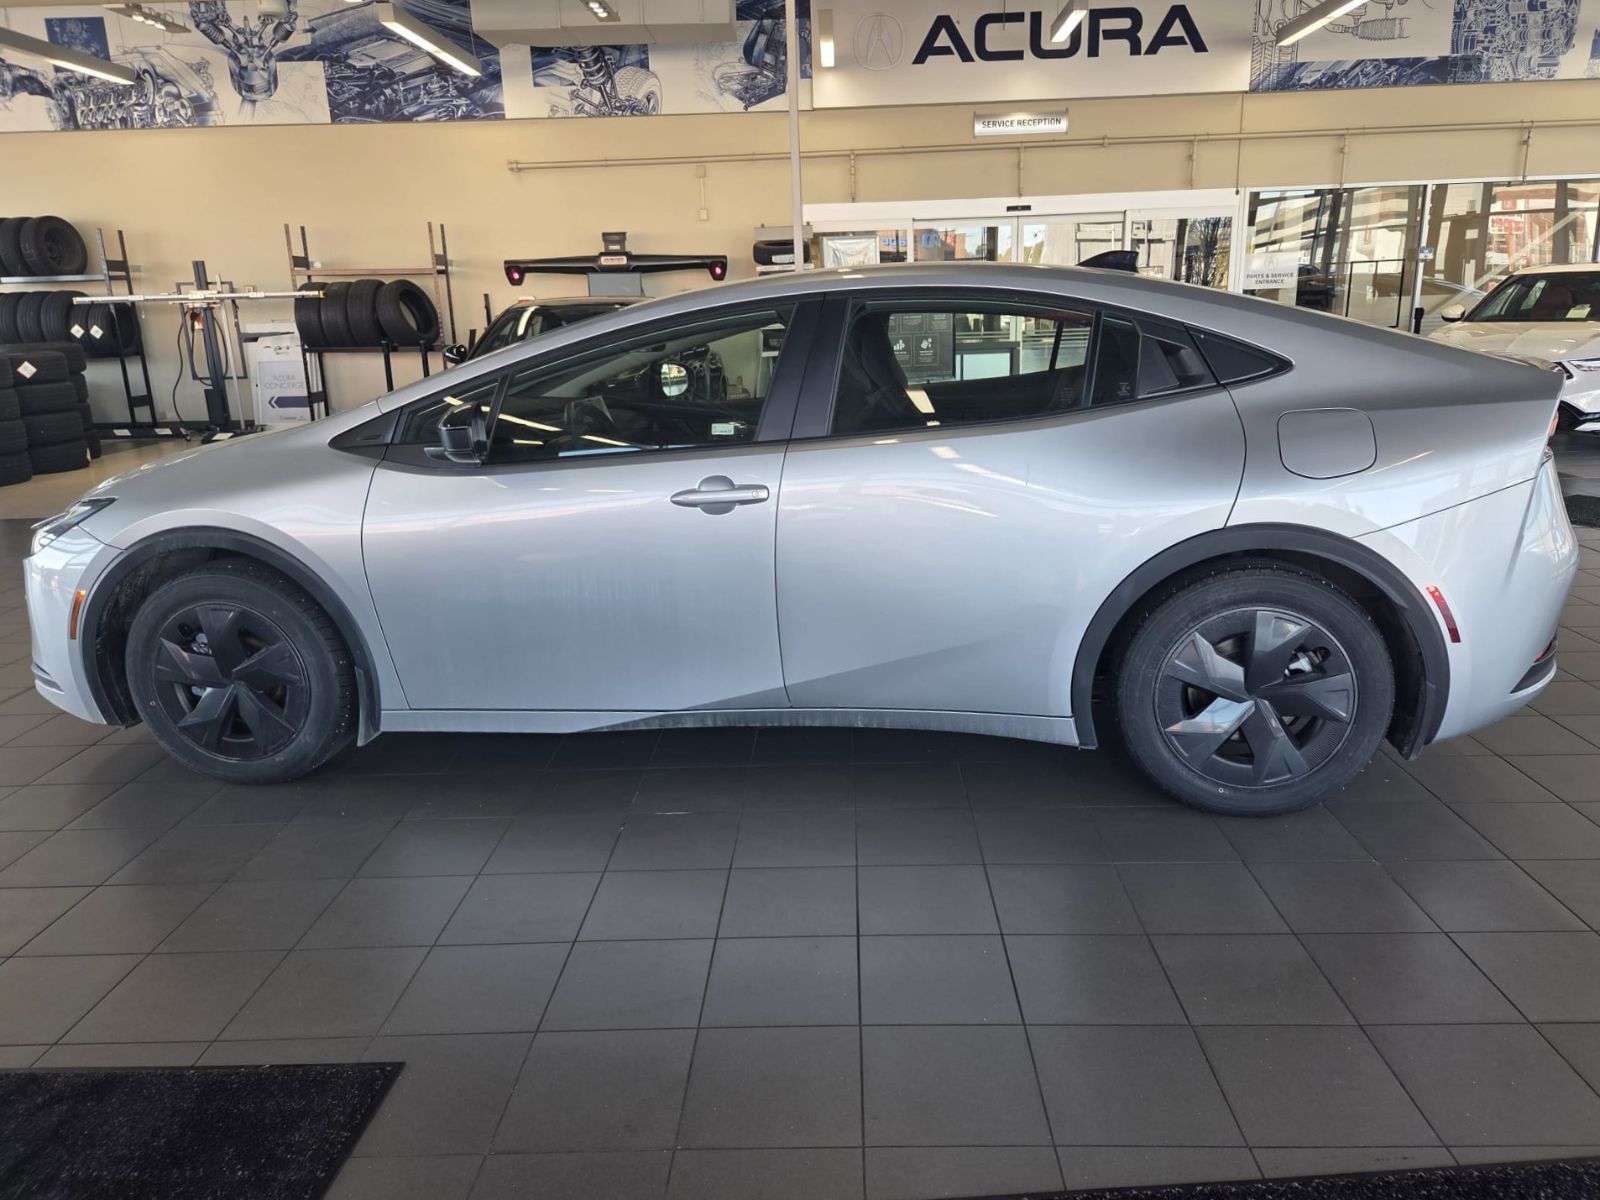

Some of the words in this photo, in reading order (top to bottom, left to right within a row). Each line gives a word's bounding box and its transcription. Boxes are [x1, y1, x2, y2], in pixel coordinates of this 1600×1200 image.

[911, 4, 1209, 65] ACURA
[981, 119, 1015, 129] SERVICE
[1016, 117, 1062, 127] RECEPTION
[263, 381, 305, 390] CONCIERGE
